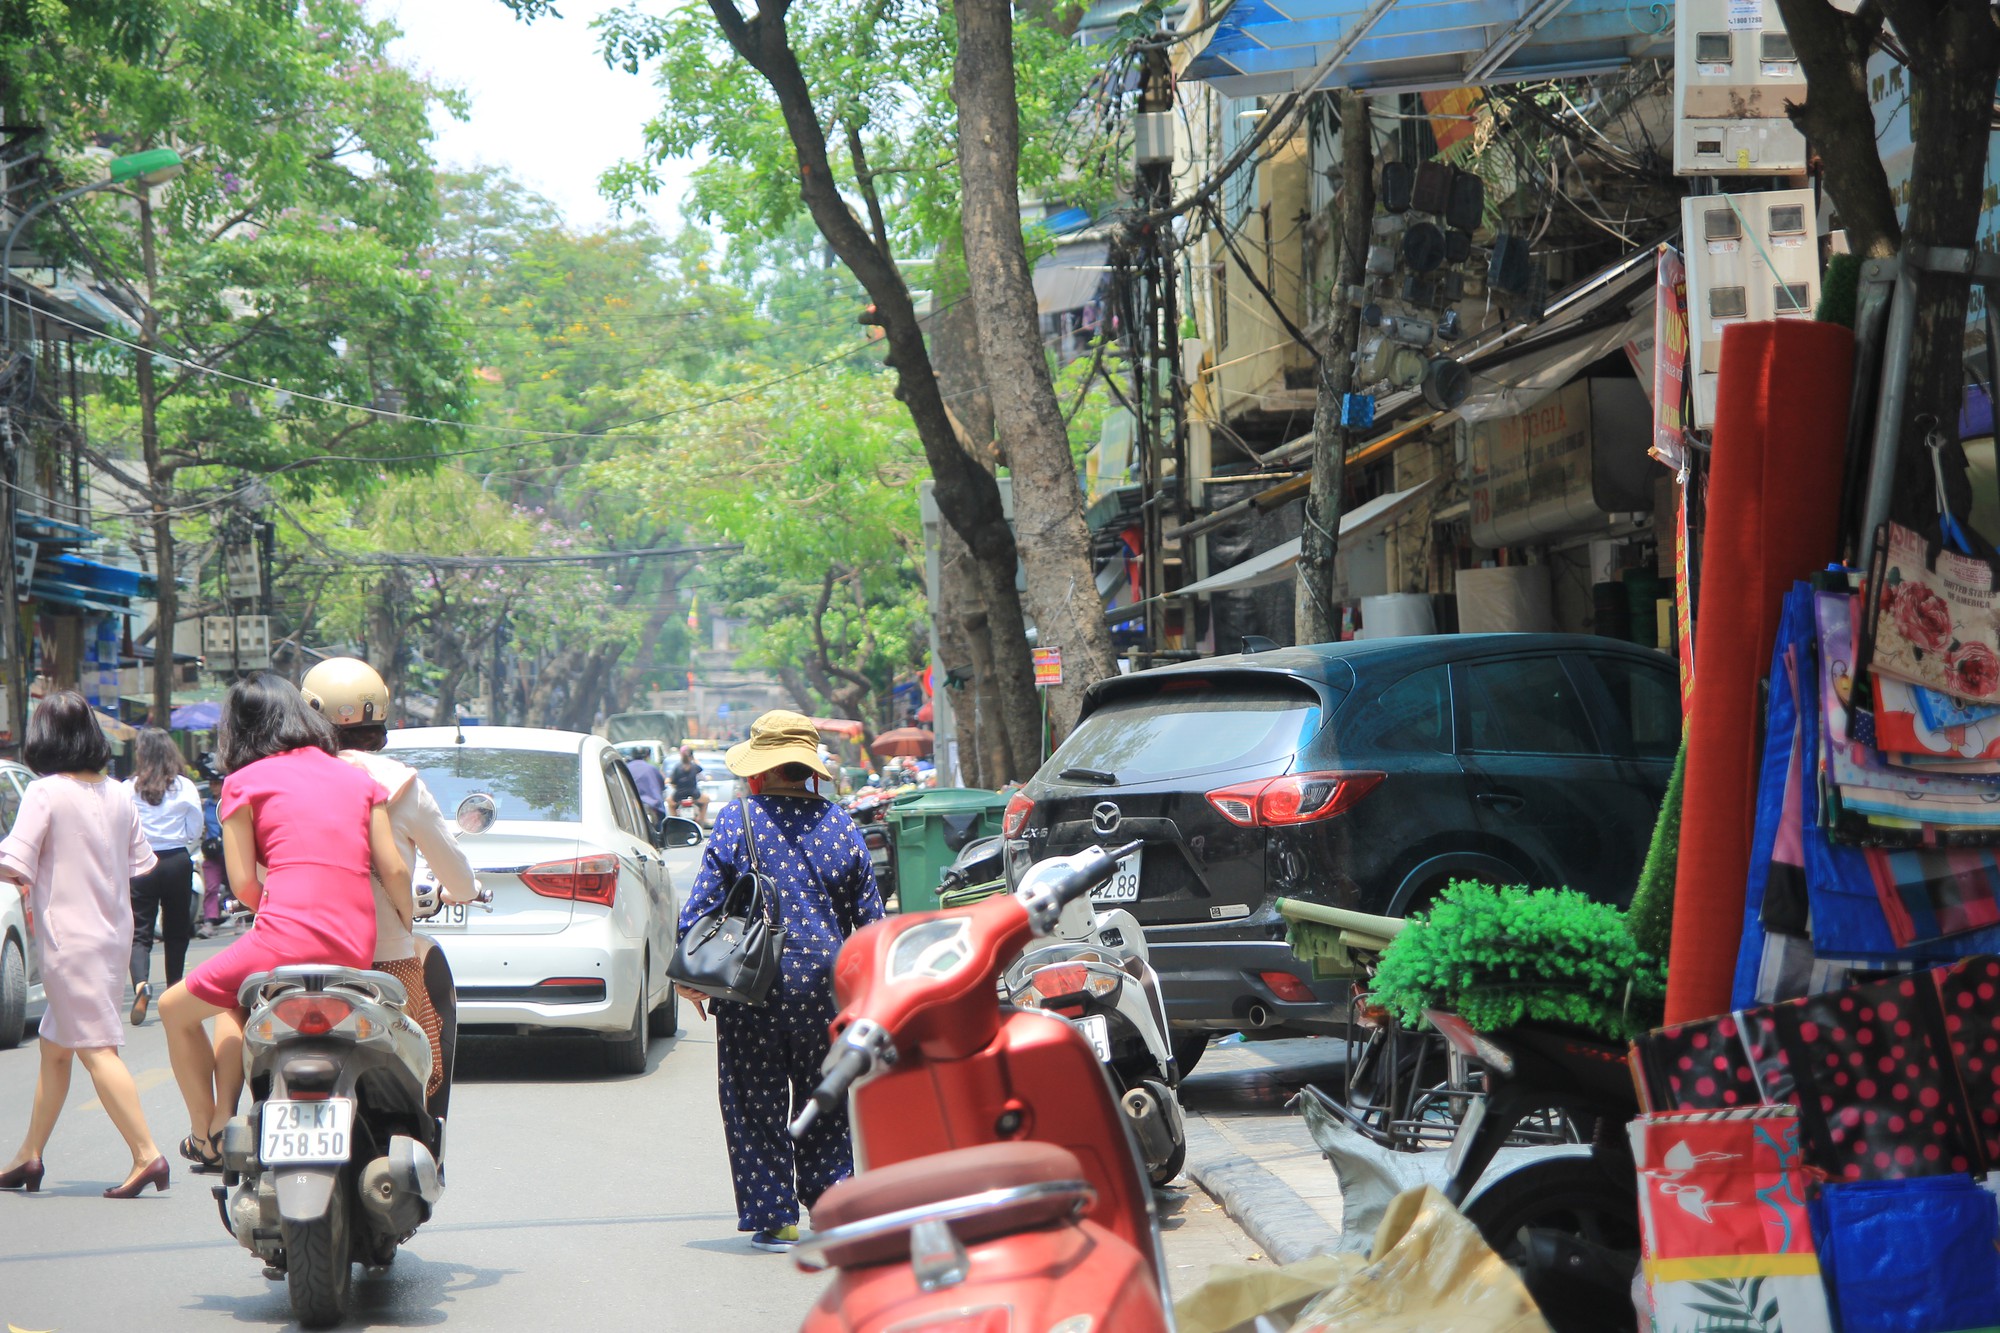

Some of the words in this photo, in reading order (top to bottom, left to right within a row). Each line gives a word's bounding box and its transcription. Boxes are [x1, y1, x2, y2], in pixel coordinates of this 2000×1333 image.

[1943, 578, 1968, 595] UNITED
[1968, 587, 1997, 599] STATES
[1955, 595, 1991, 609] AMERICA
[1021, 827, 1049, 839] CX-5
[276, 1104, 336, 1130] 29-K1
[268, 1132, 343, 1158] 758.50
